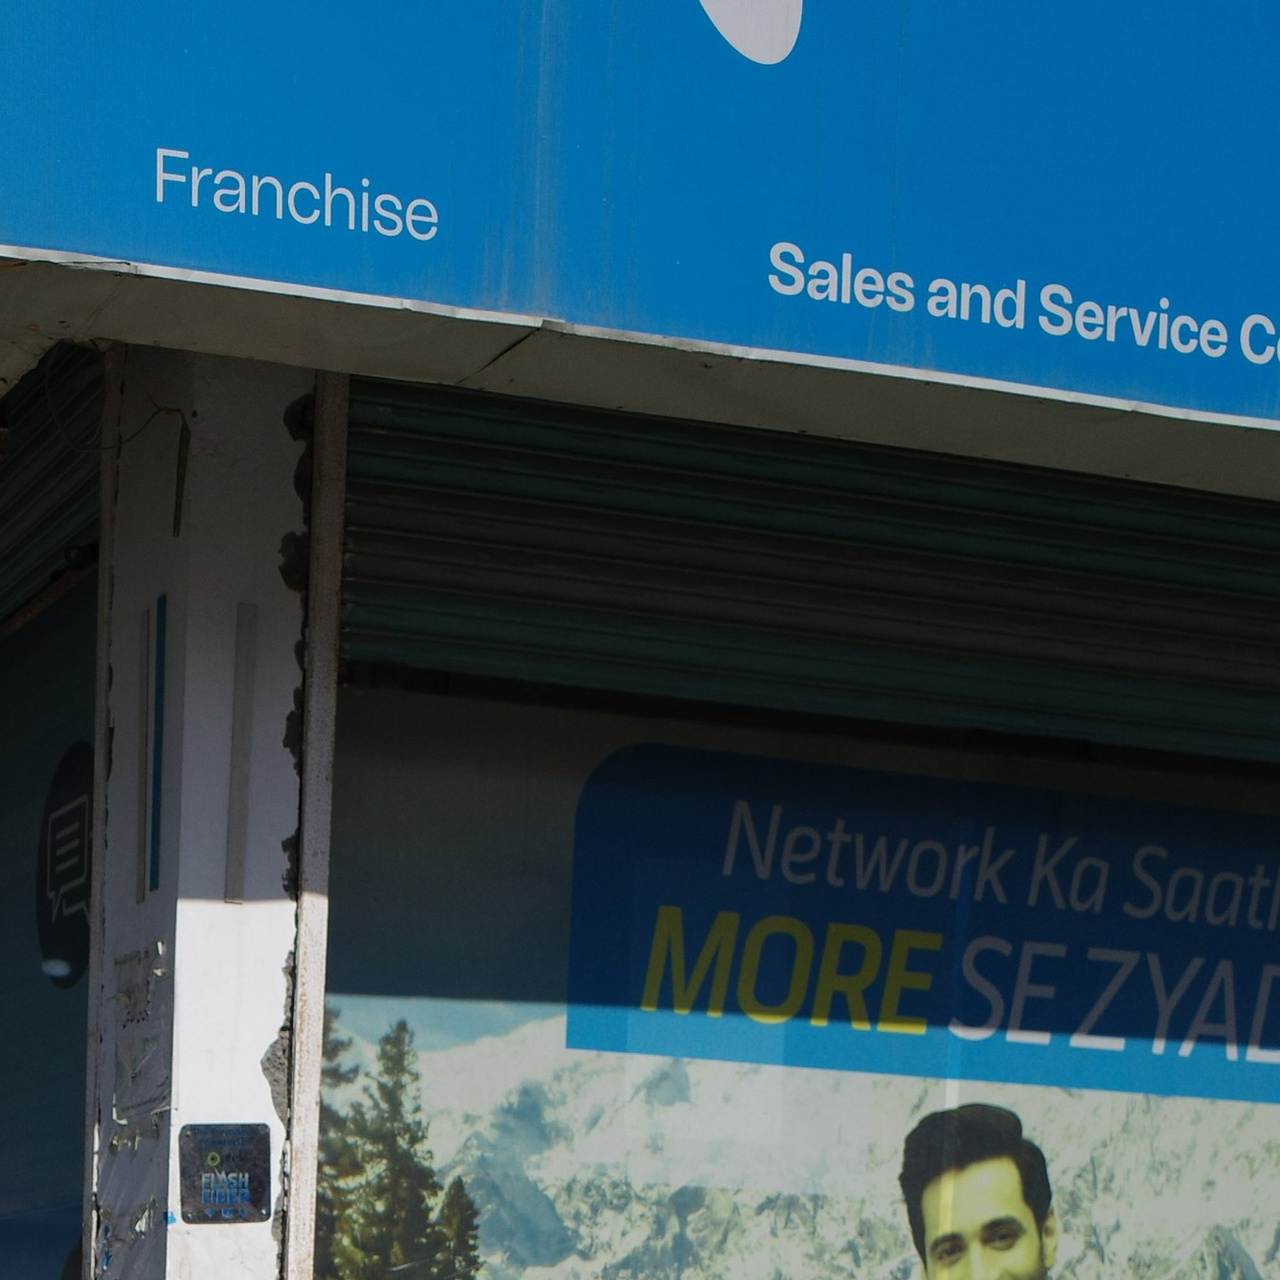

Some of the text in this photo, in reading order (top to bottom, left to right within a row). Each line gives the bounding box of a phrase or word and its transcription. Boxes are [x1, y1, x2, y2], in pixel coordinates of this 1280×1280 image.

[154, 147, 440, 242] Franchise
[767, 241, 1280, 366] Sales and Service C
[722, 799, 1017, 904] Network
[1028, 833, 1109, 913] Ka
[640, 904, 943, 1037] MORE
[948, 935, 1067, 1047] SE
